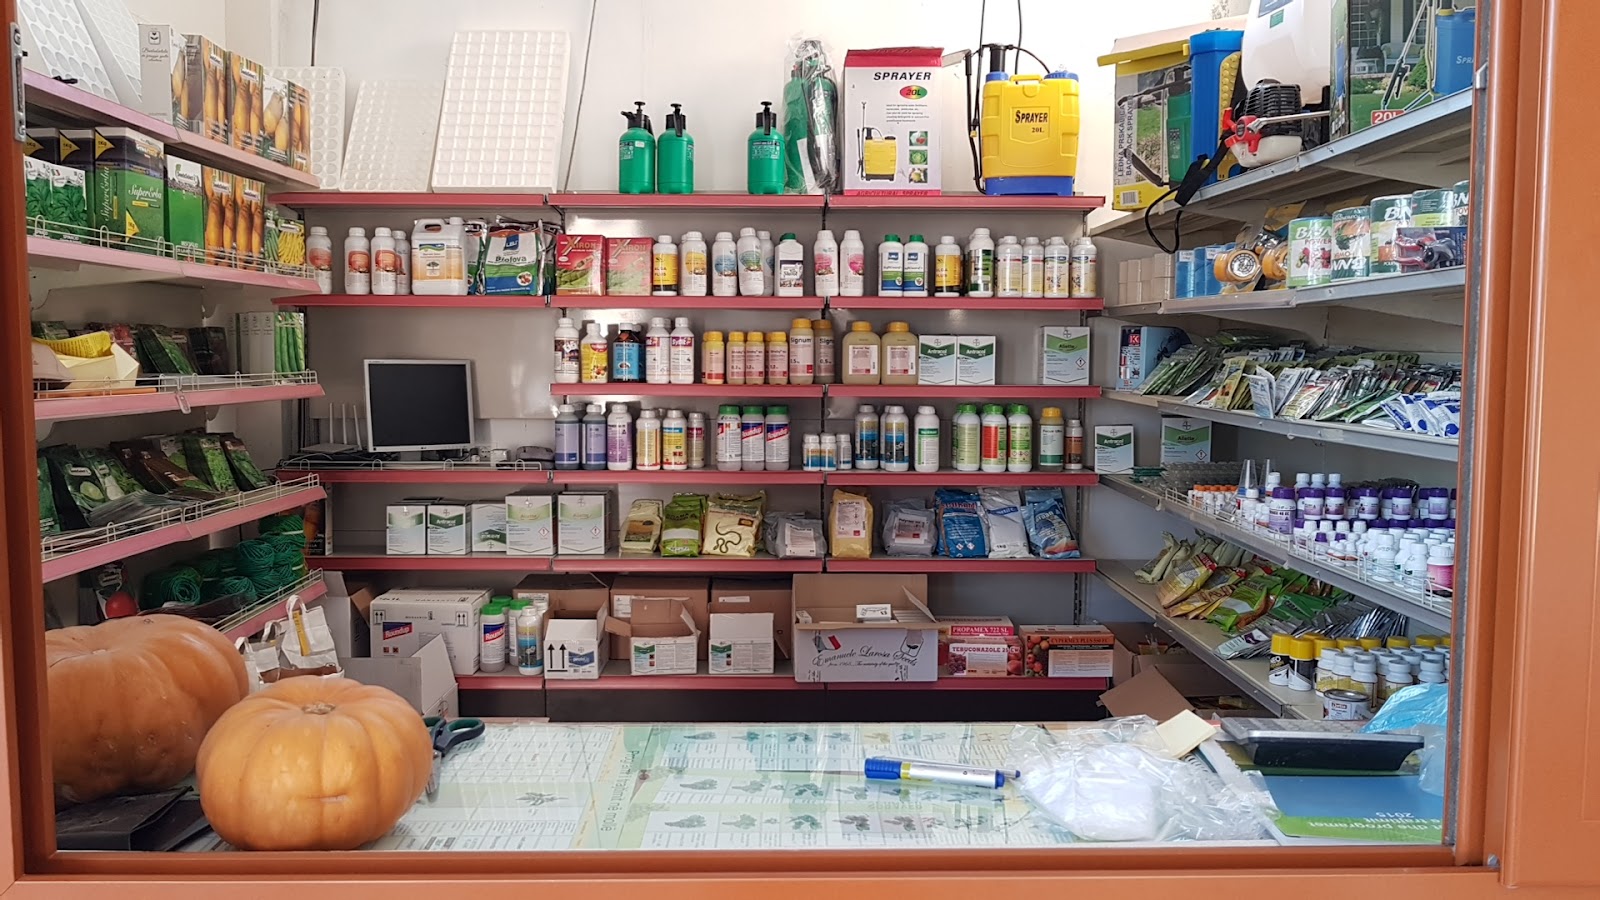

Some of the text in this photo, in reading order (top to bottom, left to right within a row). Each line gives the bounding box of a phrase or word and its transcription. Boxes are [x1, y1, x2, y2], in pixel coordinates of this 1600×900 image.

[873, 71, 932, 81] SPRAYER
[905, 88, 922, 97] 20L
[1015, 109, 1048, 124] SPRAYER
[128, 184, 162, 200] SuperErba
[790, 337, 812, 346] Signum
[812, 645, 919, 667] Emanuele Larosa Seeds
[1308, 821, 1393, 830] programet
